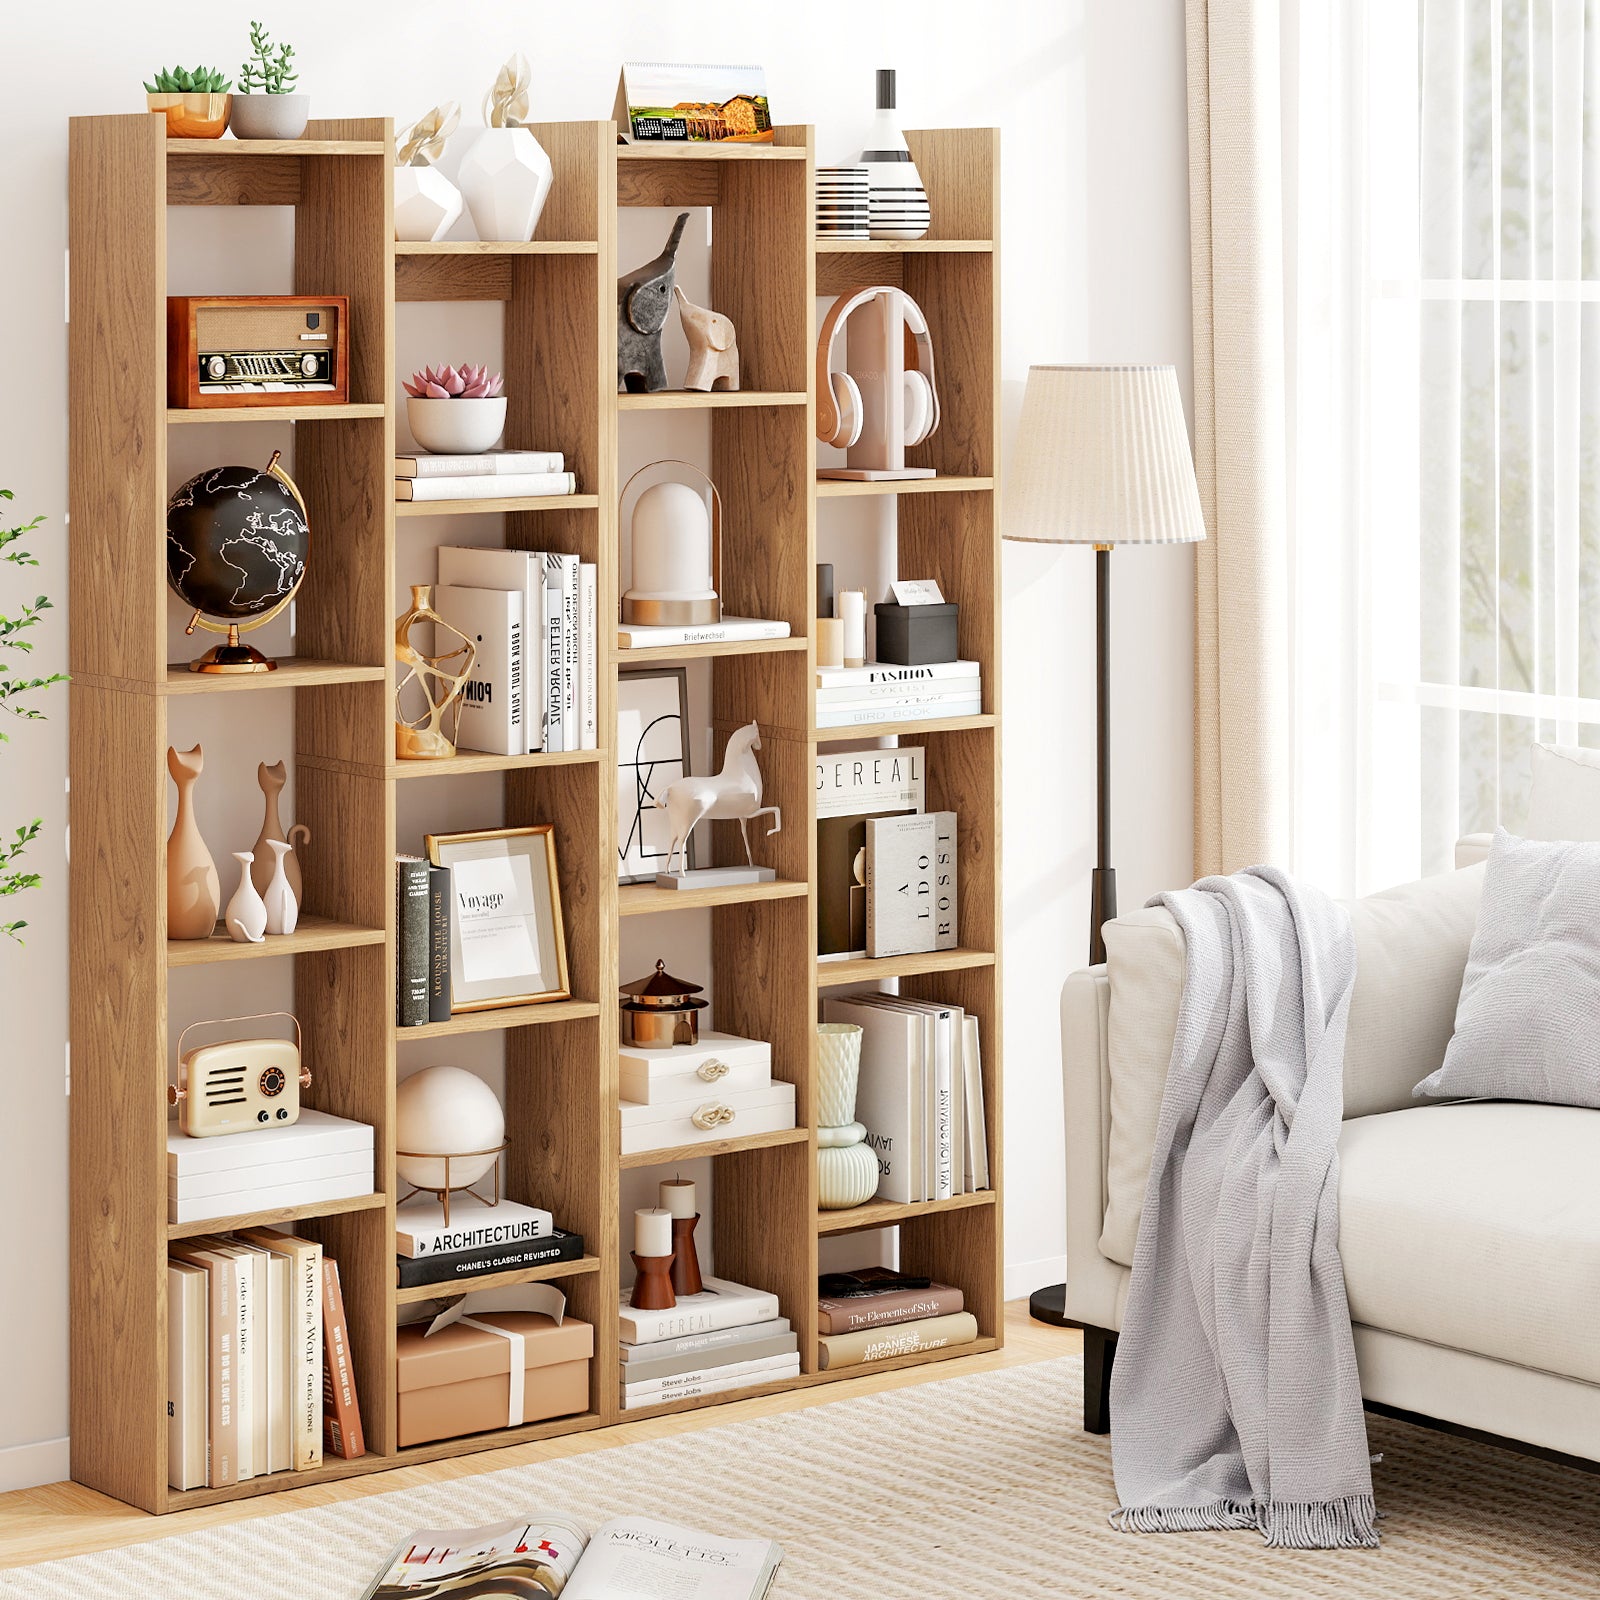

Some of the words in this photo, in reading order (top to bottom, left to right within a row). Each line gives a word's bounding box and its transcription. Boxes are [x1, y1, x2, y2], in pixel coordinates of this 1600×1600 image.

[684, 631, 725, 641] Briefwechsel
[870, 668, 934, 682] FASHION
[854, 709, 885, 722] BIRD
[893, 707, 931, 719] BOOK
[938, 835, 950, 935] ROSSI
[459, 892, 504, 911] Voyage
[433, 1220, 539, 1252] ARCHITECTURE
[456, 1260, 491, 1272] CHANEL'S
[492, 1254, 522, 1266] CLASSIC
[524, 1248, 561, 1261] REVISITED
[306, 1253, 316, 1307] TAMING
[849, 1315, 866, 1325] The
[867, 1307, 907, 1322] Elements
[908, 1304, 917, 1314] of
[917, 1301, 939, 1314] Style
[658, 1314, 713, 1337] CEREAL
[221, 1334, 230, 1352] WHY
[306, 1326, 316, 1365] WOLF
[862, 1338, 948, 1362] ARCHITECTURE
[864, 1335, 920, 1354] JAPANESE
[338, 1357, 346, 1368] WE
[221, 1368, 230, 1380] WE
[340, 1369, 349, 1387] LOVE
[662, 1379, 682, 1388] Steve
[684, 1375, 702, 1384] Jobs
[221, 1383, 231, 1403] LOVE
[306, 1374, 315, 1401] GREG
[662, 1391, 682, 1400] Steve
[684, 1387, 702, 1396] Jobs
[343, 1388, 352, 1407] CATS
[221, 1405, 231, 1426] CATS
[306, 1402, 314, 1434] STONE
